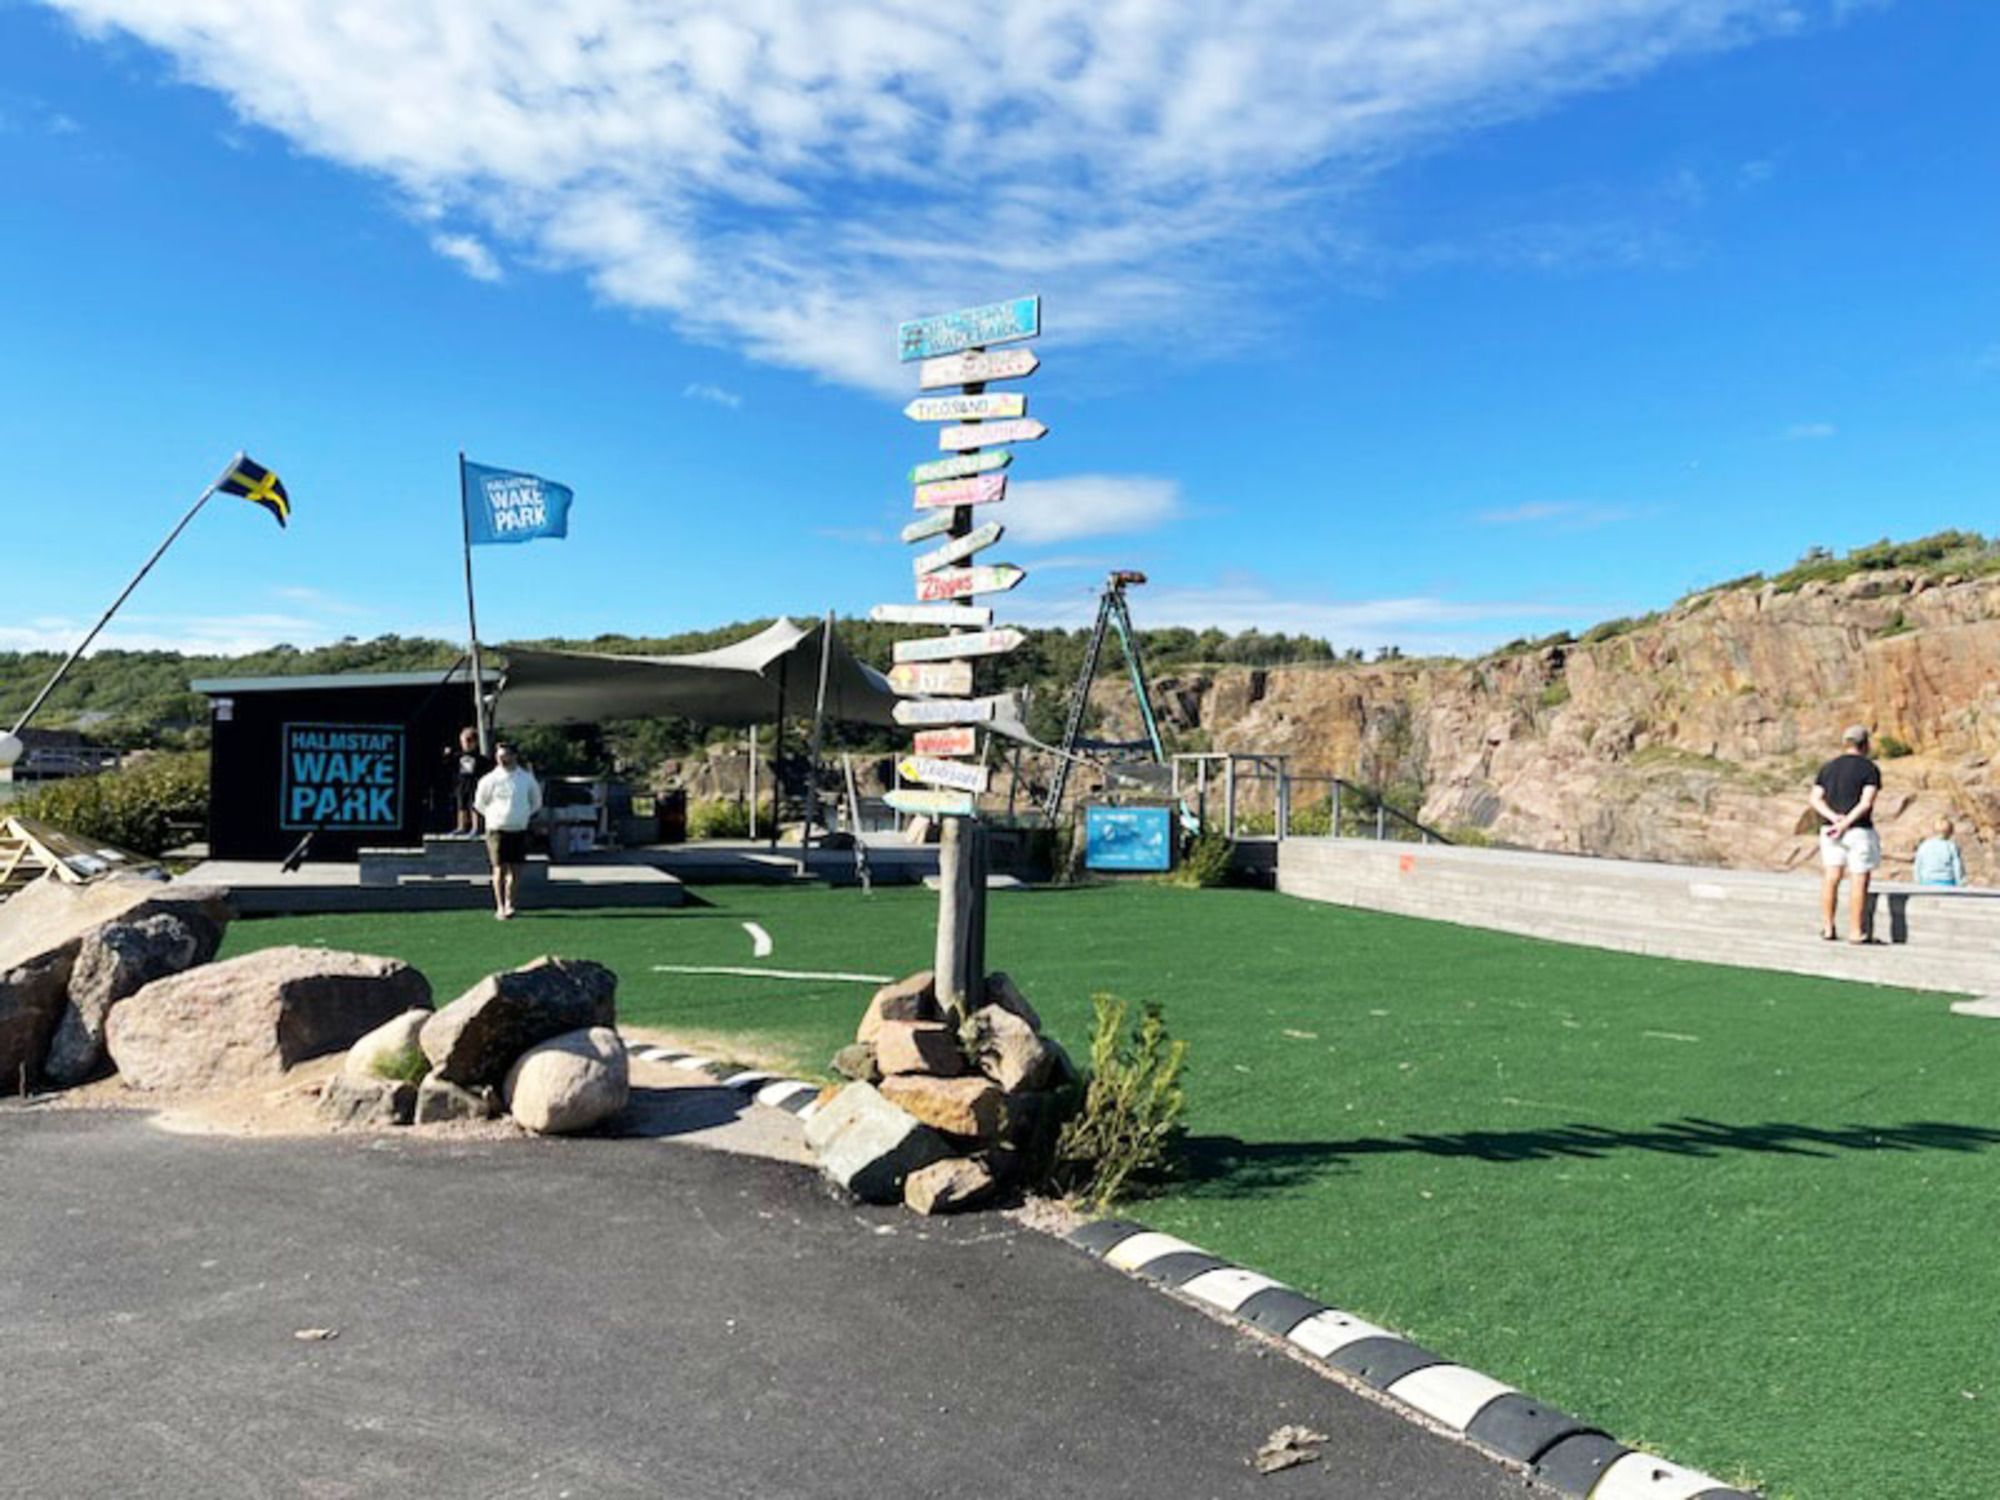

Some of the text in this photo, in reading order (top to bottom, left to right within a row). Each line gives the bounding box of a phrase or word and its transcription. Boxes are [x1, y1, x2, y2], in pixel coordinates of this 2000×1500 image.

[488, 485, 546, 510] WAKE
[494, 504, 548, 533] PARK
[291, 751, 395, 784] WAKE
[291, 786, 395, 821] PARK
